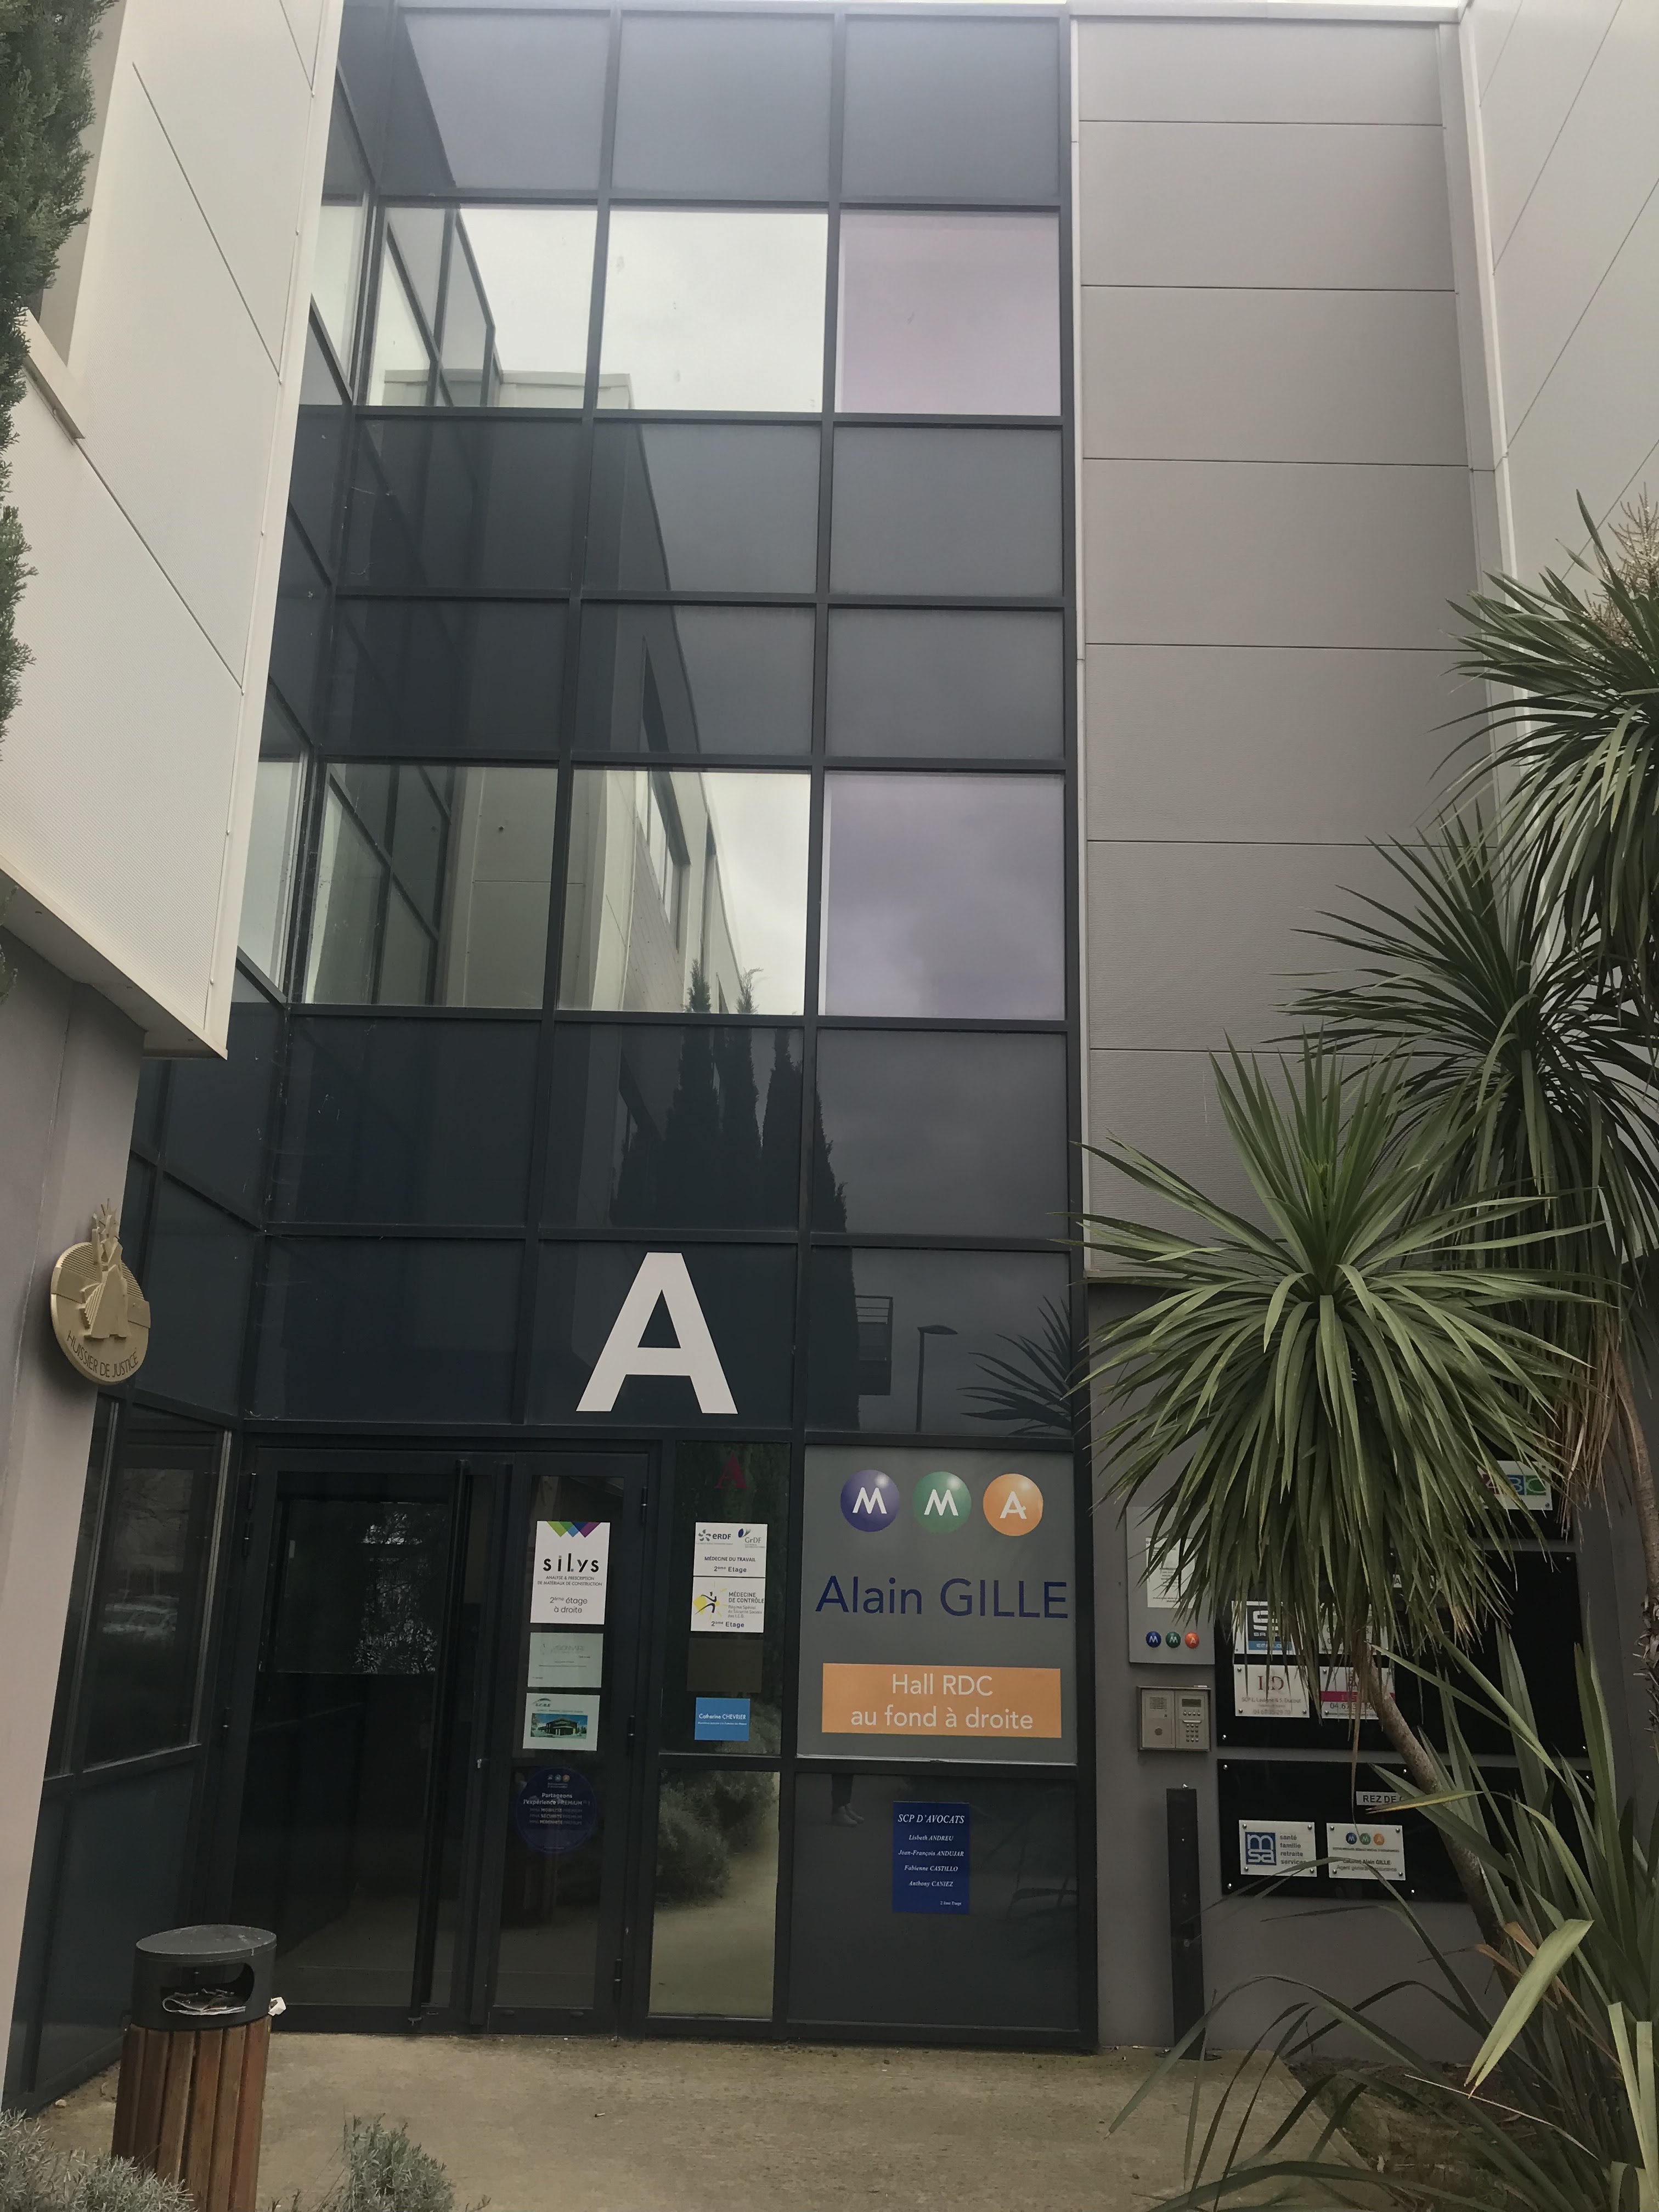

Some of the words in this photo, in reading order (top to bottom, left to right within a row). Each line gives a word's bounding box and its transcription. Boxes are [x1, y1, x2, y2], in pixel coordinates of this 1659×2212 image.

[576, 1252, 738, 1414] A
[66, 1329, 98, 1372] HUISSIER
[100, 1362, 110, 1378] DE
[112, 1351, 139, 1377] JUSTICE
[714, 1454, 747, 1489] A
[566, 1596, 588, 1606] étage
[815, 1575, 922, 1615] Alain
[940, 1578, 1068, 1618] GILLE
[892, 1673, 933, 1695] Hall
[943, 1675, 993, 1696] RDC
[851, 1709, 876, 1726] au
[884, 1705, 936, 1727] fond
[945, 1707, 957, 1728] à
[966, 1708, 1033, 1729] droite
[1363, 1795, 1382, 1803] REZ
[898, 1814, 915, 1822] SCP
[917, 1814, 965, 1824] D'AVOCATS
